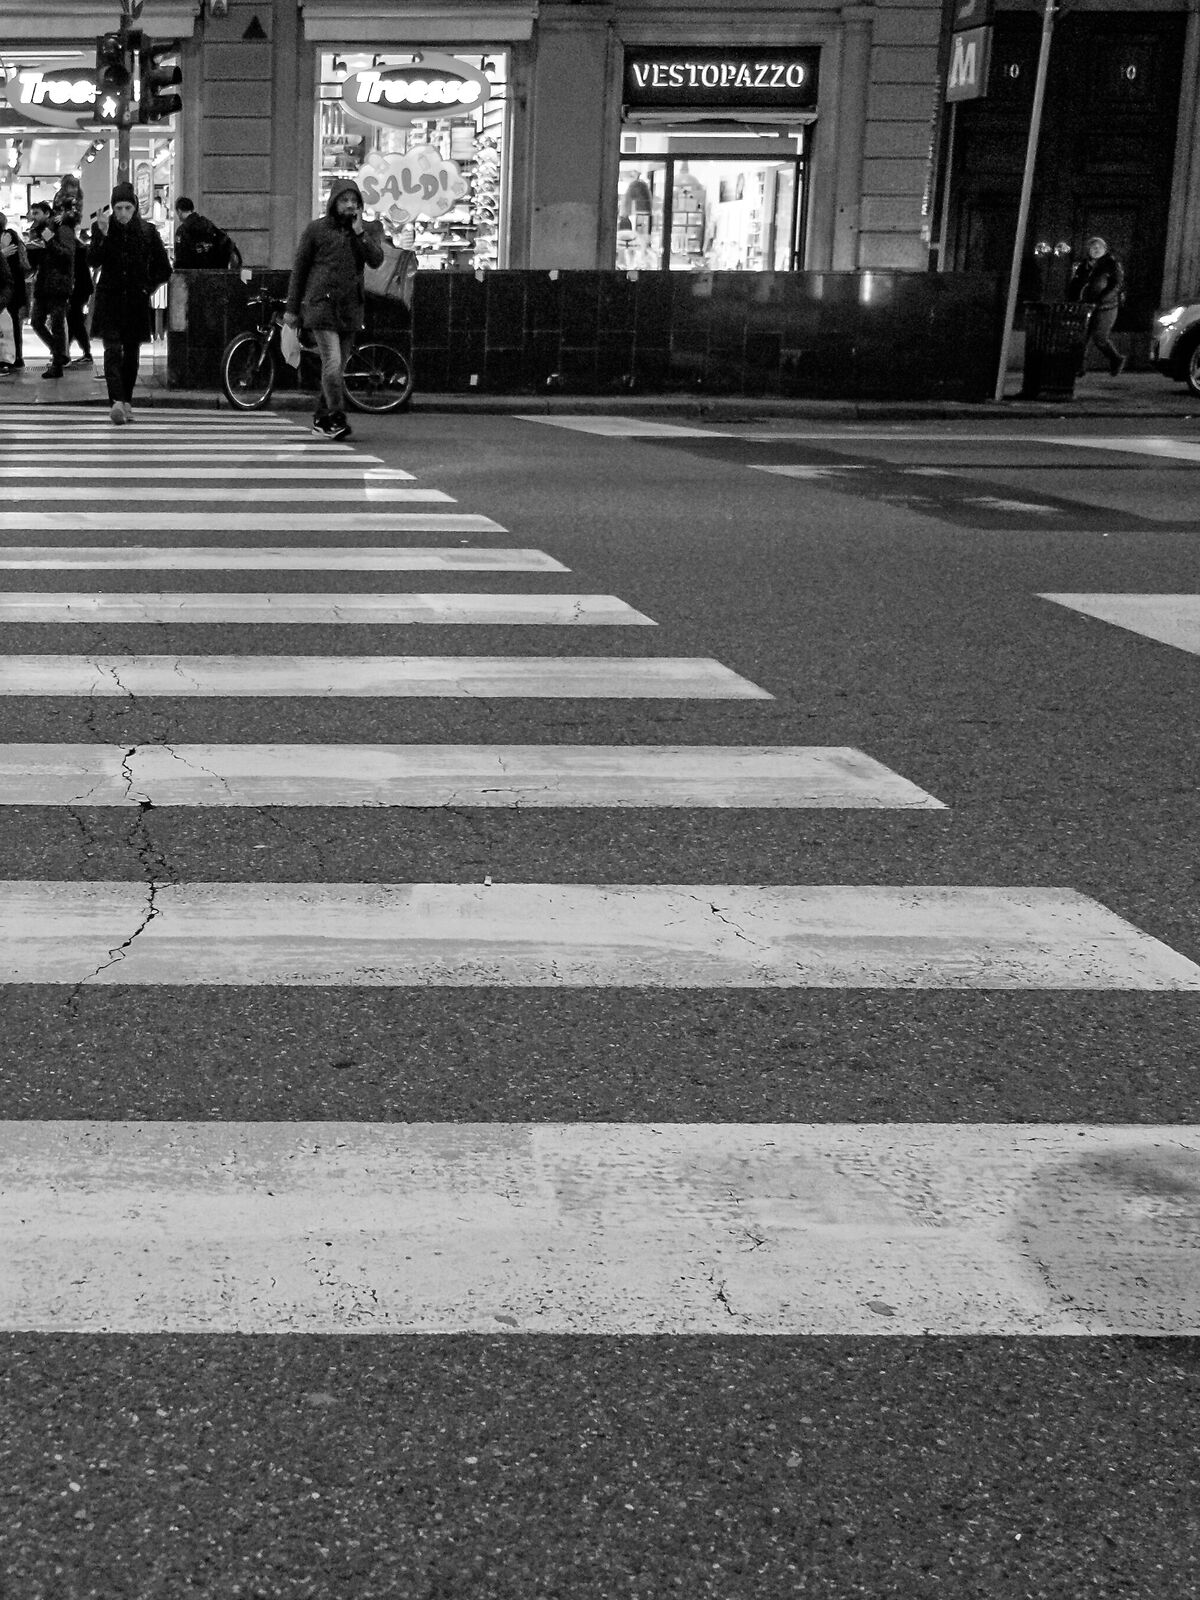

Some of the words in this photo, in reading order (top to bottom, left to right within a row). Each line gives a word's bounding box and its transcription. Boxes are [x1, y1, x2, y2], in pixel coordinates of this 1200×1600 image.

[18, 72, 98, 104] Tree
[356, 71, 482, 104] Treesse
[632, 63, 805, 88] VESTOPAZZO
[361, 167, 448, 205] SALDI
